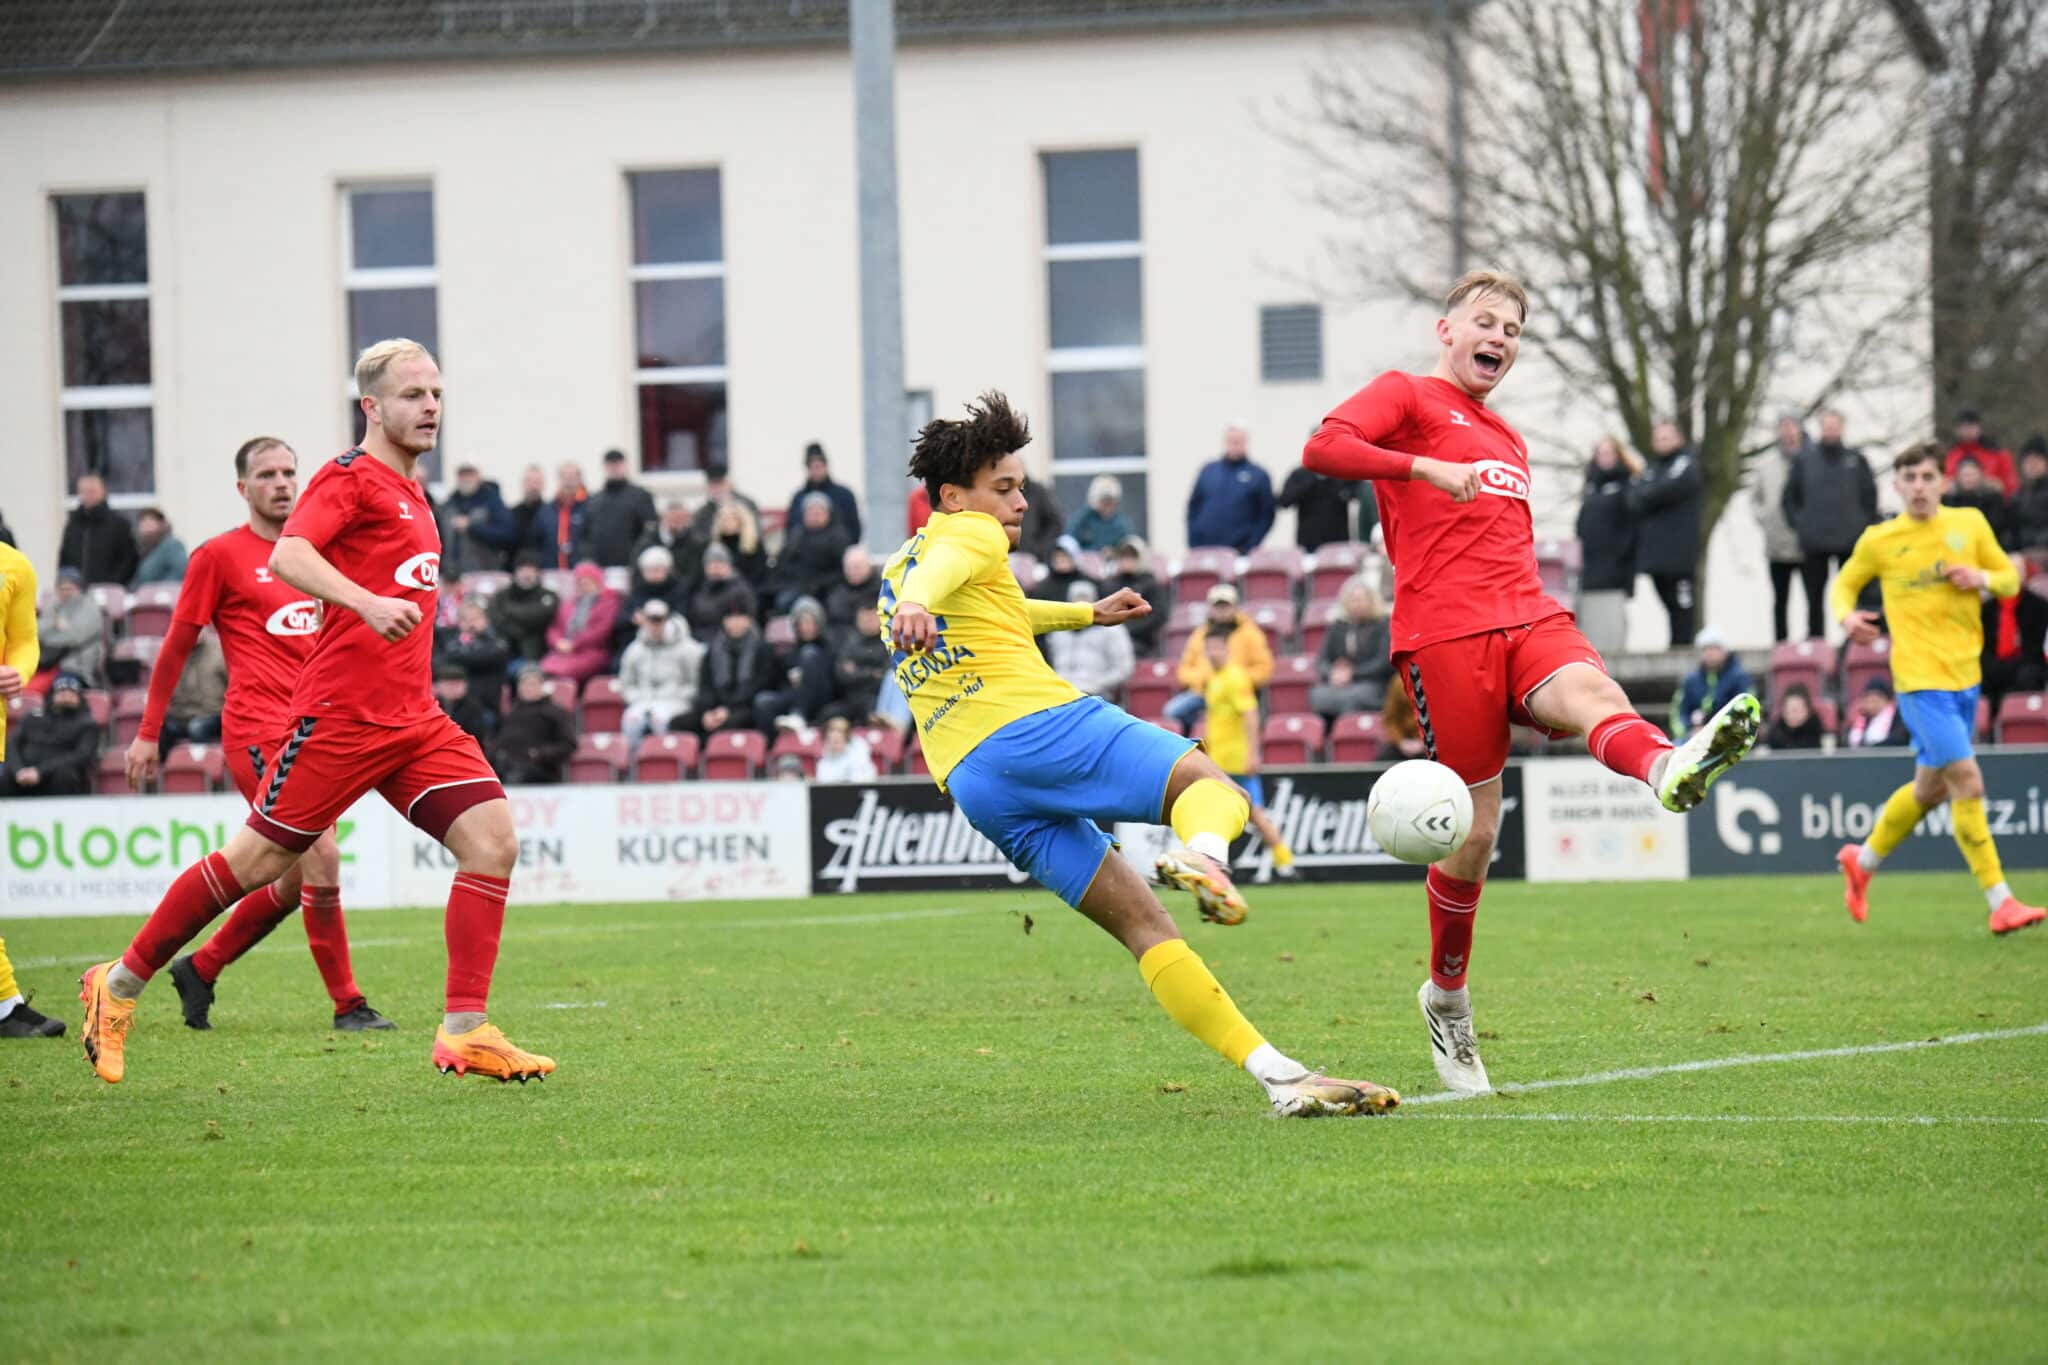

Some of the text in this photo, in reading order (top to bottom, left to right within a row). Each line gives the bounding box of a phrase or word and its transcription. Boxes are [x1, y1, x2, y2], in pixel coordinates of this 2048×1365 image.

[963, 676, 984, 697] Hof
[617, 793, 767, 825] REDDY
[618, 830, 770, 864] KÜCHEN
